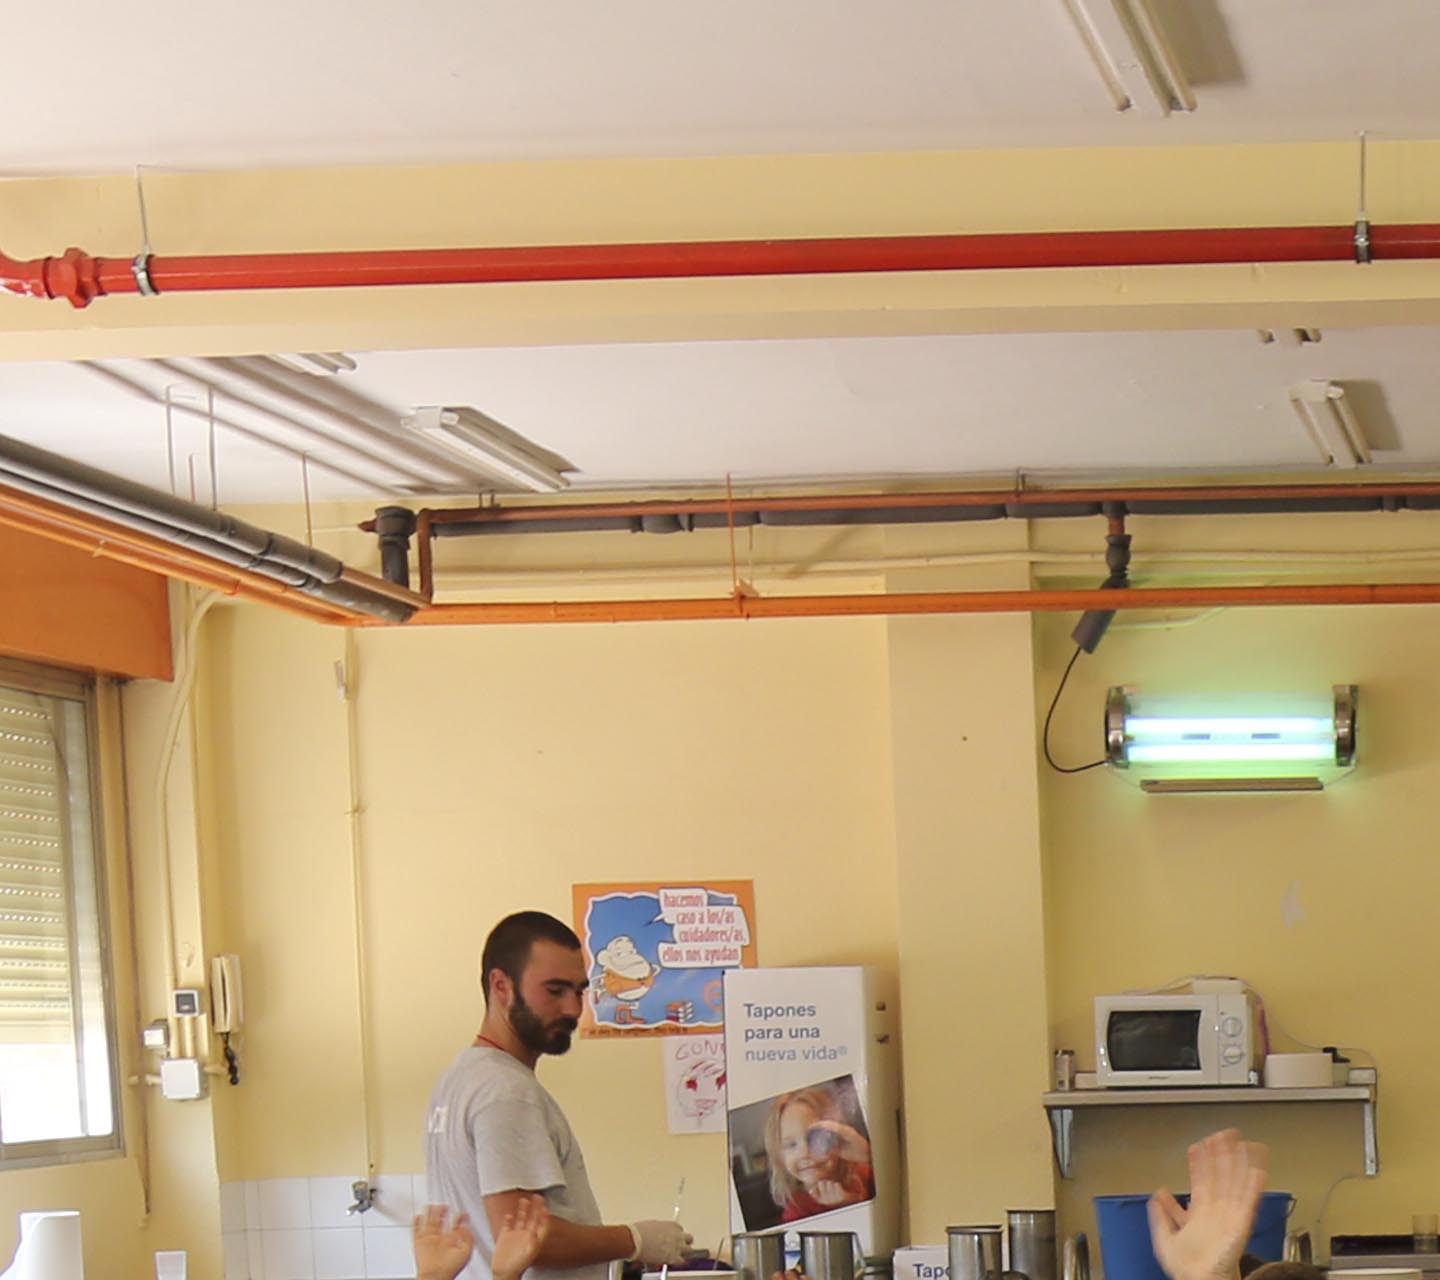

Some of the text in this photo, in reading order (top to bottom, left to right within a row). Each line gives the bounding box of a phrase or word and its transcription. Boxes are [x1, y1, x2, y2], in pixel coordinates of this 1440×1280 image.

[663, 891, 705, 908] hacemos
[743, 1003, 817, 1020] Tapones
[744, 1026, 821, 1042] para una
[745, 1048, 797, 1061] nueva
